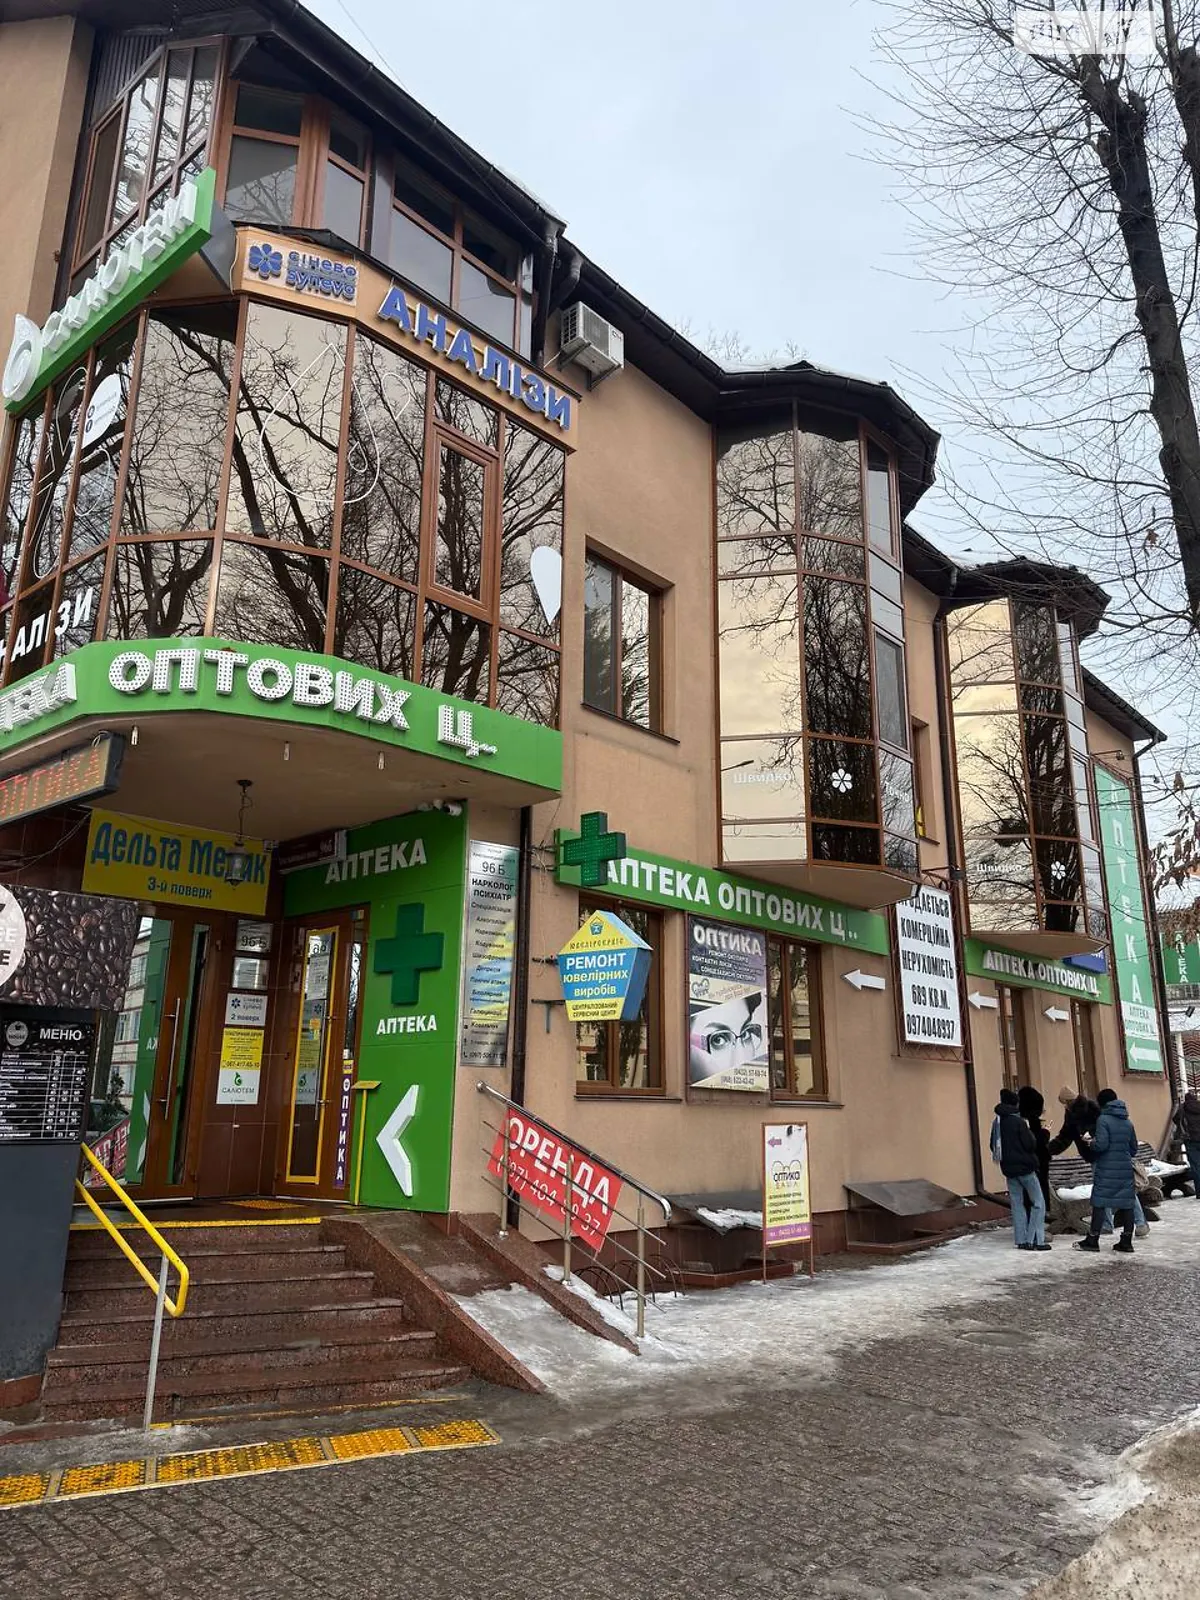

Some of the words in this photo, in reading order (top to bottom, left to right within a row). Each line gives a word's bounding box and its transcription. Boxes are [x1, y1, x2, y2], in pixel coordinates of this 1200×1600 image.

[377, 287, 572, 431] АНАЛІЗИ
[109, 647, 411, 731] ОПТОВИХ
[90, 822, 182, 871] Дельта
[324, 838, 427, 884] АПТЕКА
[482, 860, 496, 874] 96
[498, 864, 506, 876] Б
[471, 878, 515, 891] НАРКОЛОГ
[473, 889, 512, 901] ПСИХІАТР
[606, 856, 710, 905] АПТЕКА
[718, 882, 824, 932] ОПТОВИХ
[693, 925, 762, 957] ОПТИКА
[900, 916, 951, 948] КОМЕРЦІЙНА
[563, 969, 629, 985] ювелірних
[566, 953, 627, 970] РЕМОНТ
[901, 949, 954, 980] НЕРУХОМІСТЬ
[983, 950, 1036, 980] АПТЕКА
[1038, 963, 1087, 992] ОПТОВИХ
[574, 984, 617, 998] виробів
[911, 984, 928, 1006] 689
[39, 1028, 82, 1041] МЕНЮ
[376, 1014, 438, 1035] АПТЕКА
[336, 1078, 351, 1181] ОПТИКА
[509, 1117, 612, 1216] ОРЕНДА
[530, 1179, 558, 1207] 404
[580, 1213, 601, 1237] 37
